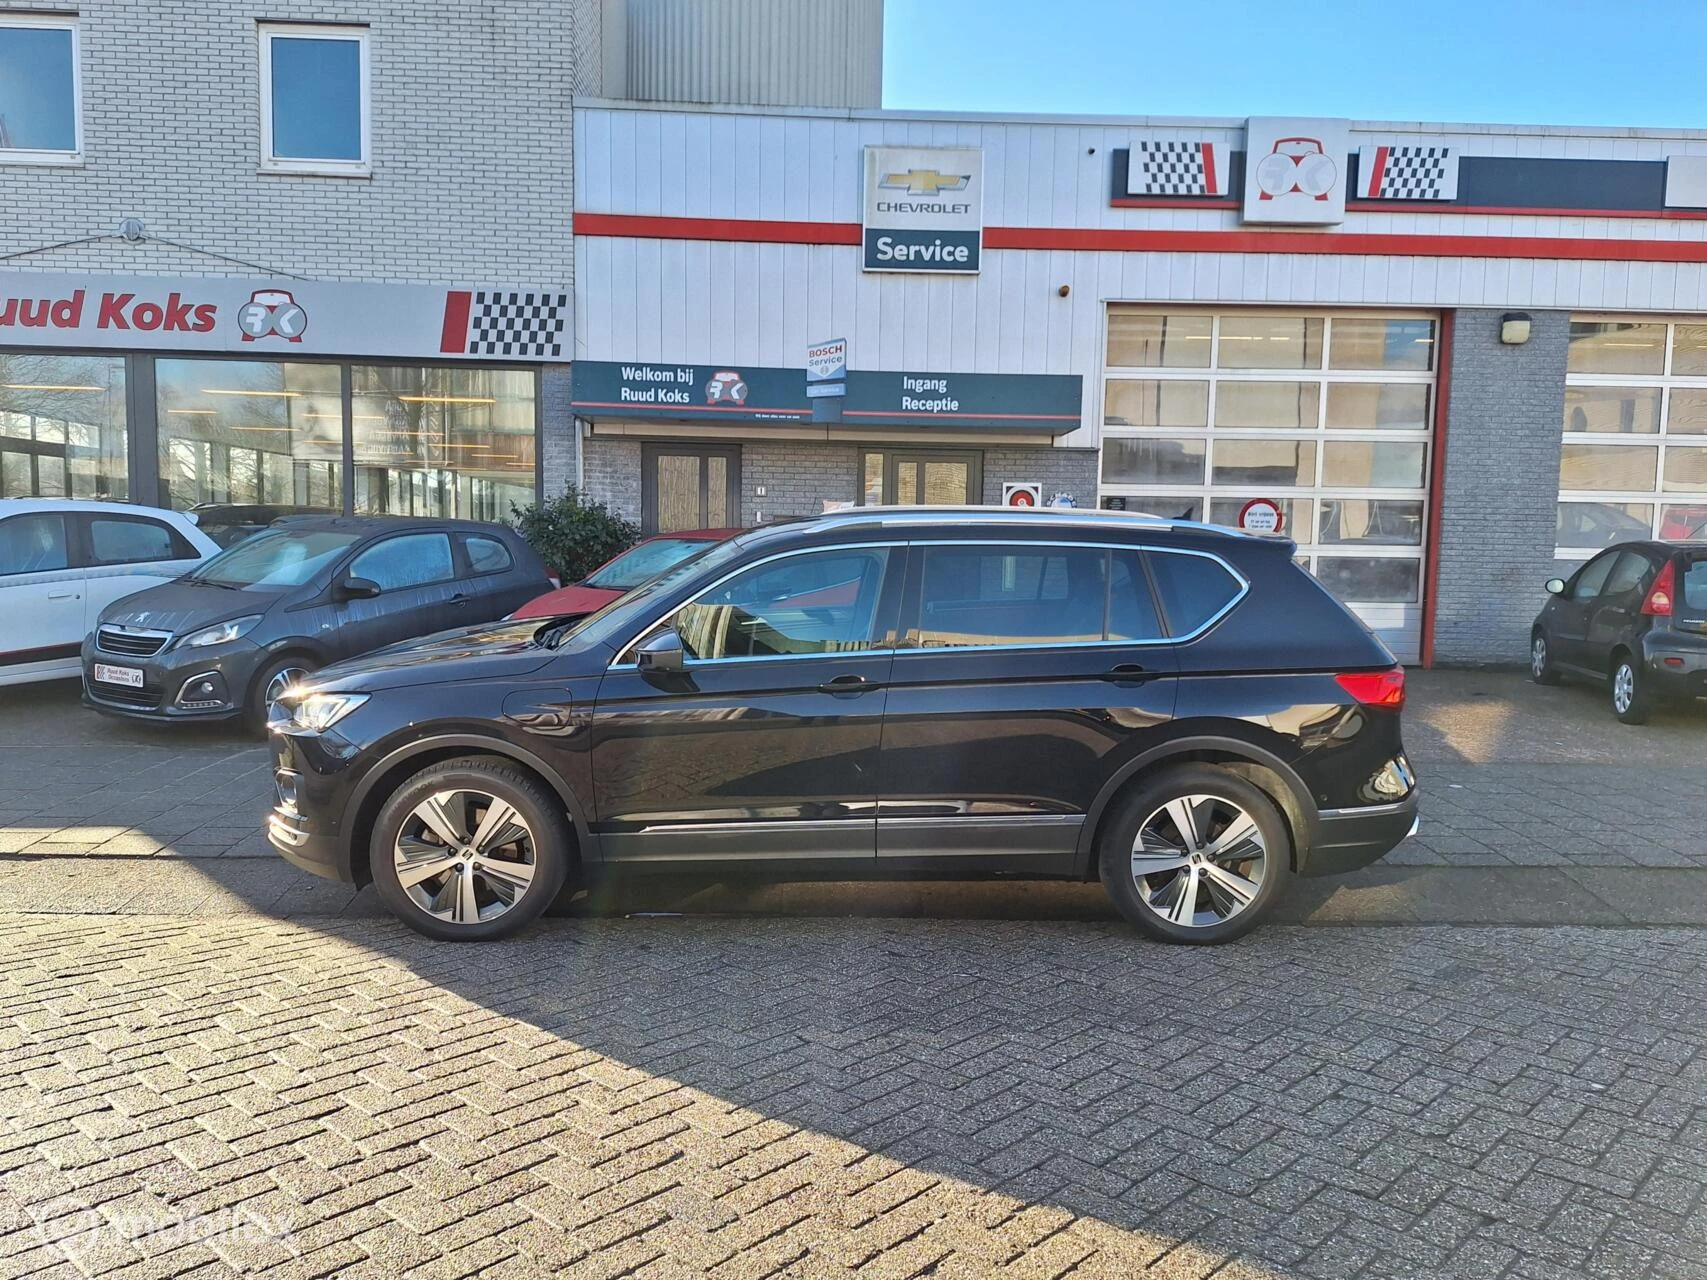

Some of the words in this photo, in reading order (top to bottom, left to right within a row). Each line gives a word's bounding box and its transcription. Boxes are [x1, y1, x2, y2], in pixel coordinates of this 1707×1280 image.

[876, 201, 971, 214] CHEVROLET
[876, 236, 969, 262] Service
[97, 292, 217, 332] Koks
[808, 344, 843, 358] BOSCH
[808, 356, 843, 367] Service
[621, 366, 674, 382] Welkom
[677, 368, 694, 386] bij
[903, 375, 948, 393] Ingang
[620, 387, 655, 401] Ruud
[658, 388, 690, 403] Koks
[902, 396, 960, 413] Receptie
